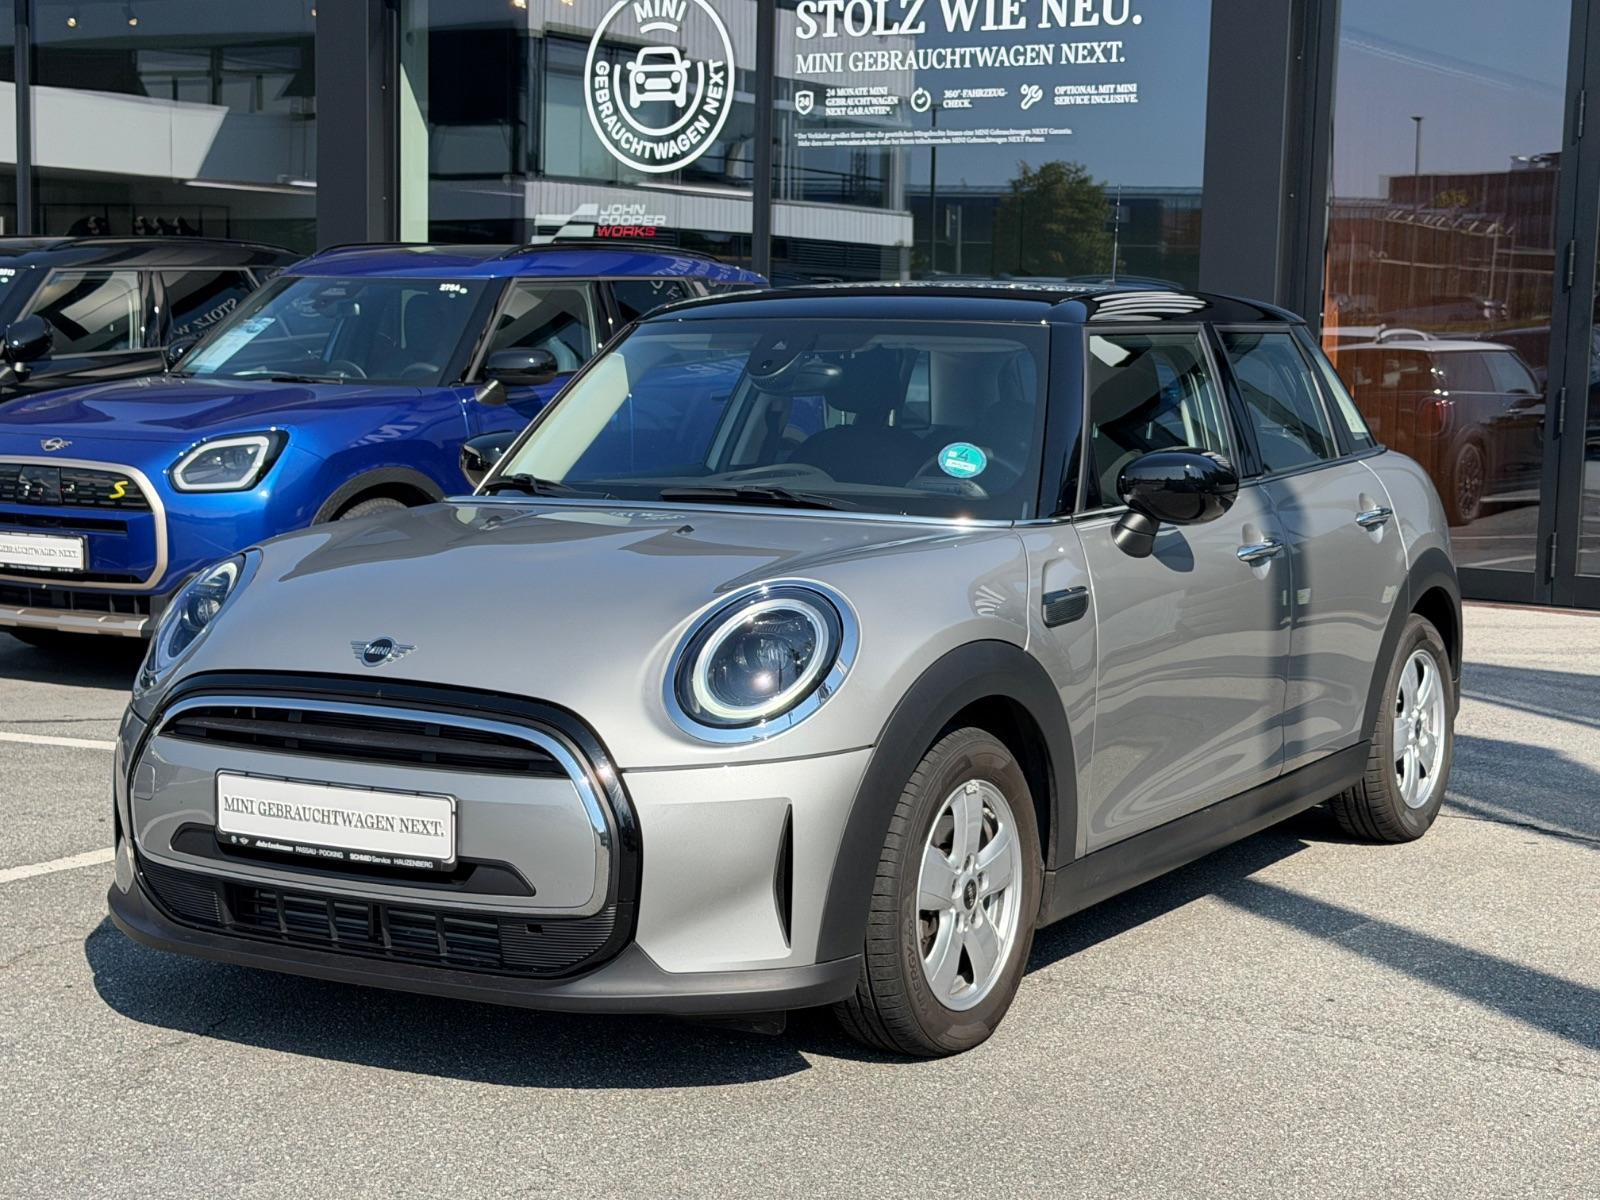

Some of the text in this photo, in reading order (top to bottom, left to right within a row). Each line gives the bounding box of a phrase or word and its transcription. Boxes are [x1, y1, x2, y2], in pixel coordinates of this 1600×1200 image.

[634, 0, 687, 23] MINI
[795, 0, 1143, 40] STOLZ WIE NEU.
[795, 41, 1126, 74] MINI GEBRAUCHTWAGEN NEXT.
[825, 86, 889, 97] 24 MONATE MINI
[1054, 83, 1138, 95] OPTIONAL MIT MINI
[825, 96, 899, 106] GEBRAUCHTWAGEN
[942, 99, 973, 108] CHECK.
[1054, 95, 1090, 105] SERVICE
[594, 59, 725, 160] GEBRAUCHTWAGEN NEXT
[825, 107, 847, 116] NEXT
[600, 203, 646, 215] JOHN
[598, 214, 667, 226] COOPER
[596, 225, 657, 238] WORKS
[366, 645, 391, 655] MINI
[223, 796, 445, 837] MINI GEBRAUCHTWAGEN NEXT.
